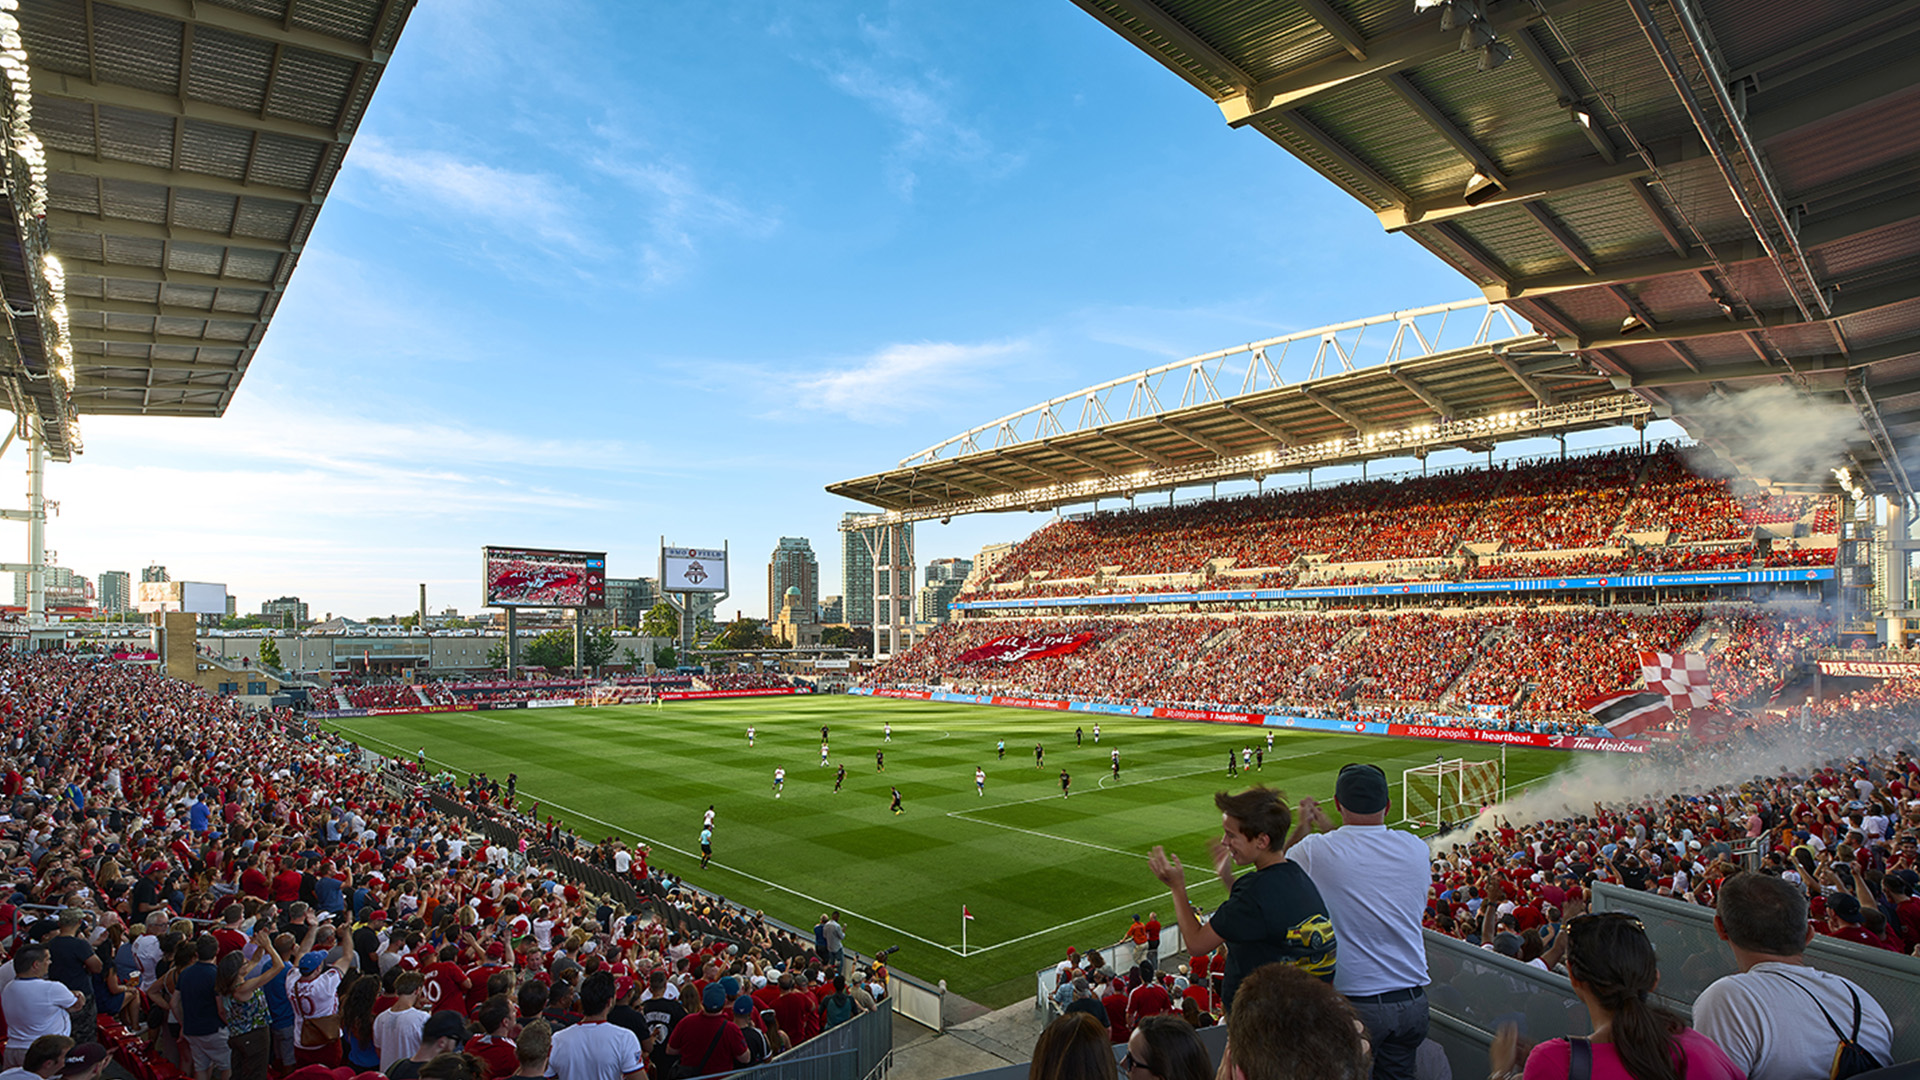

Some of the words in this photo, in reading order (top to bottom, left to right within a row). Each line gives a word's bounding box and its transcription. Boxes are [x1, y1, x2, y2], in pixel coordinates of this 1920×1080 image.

[1848, 663, 1920, 676] FORTRES
[1407, 726, 1437, 737] 30,000
[1437, 728, 1471, 740] people.
[1473, 731, 1479, 739] 1
[1481, 731, 1534, 744] heartbeat.
[1573, 737, 1595, 749] Tim
[1595, 738, 1645, 753] Hortons
